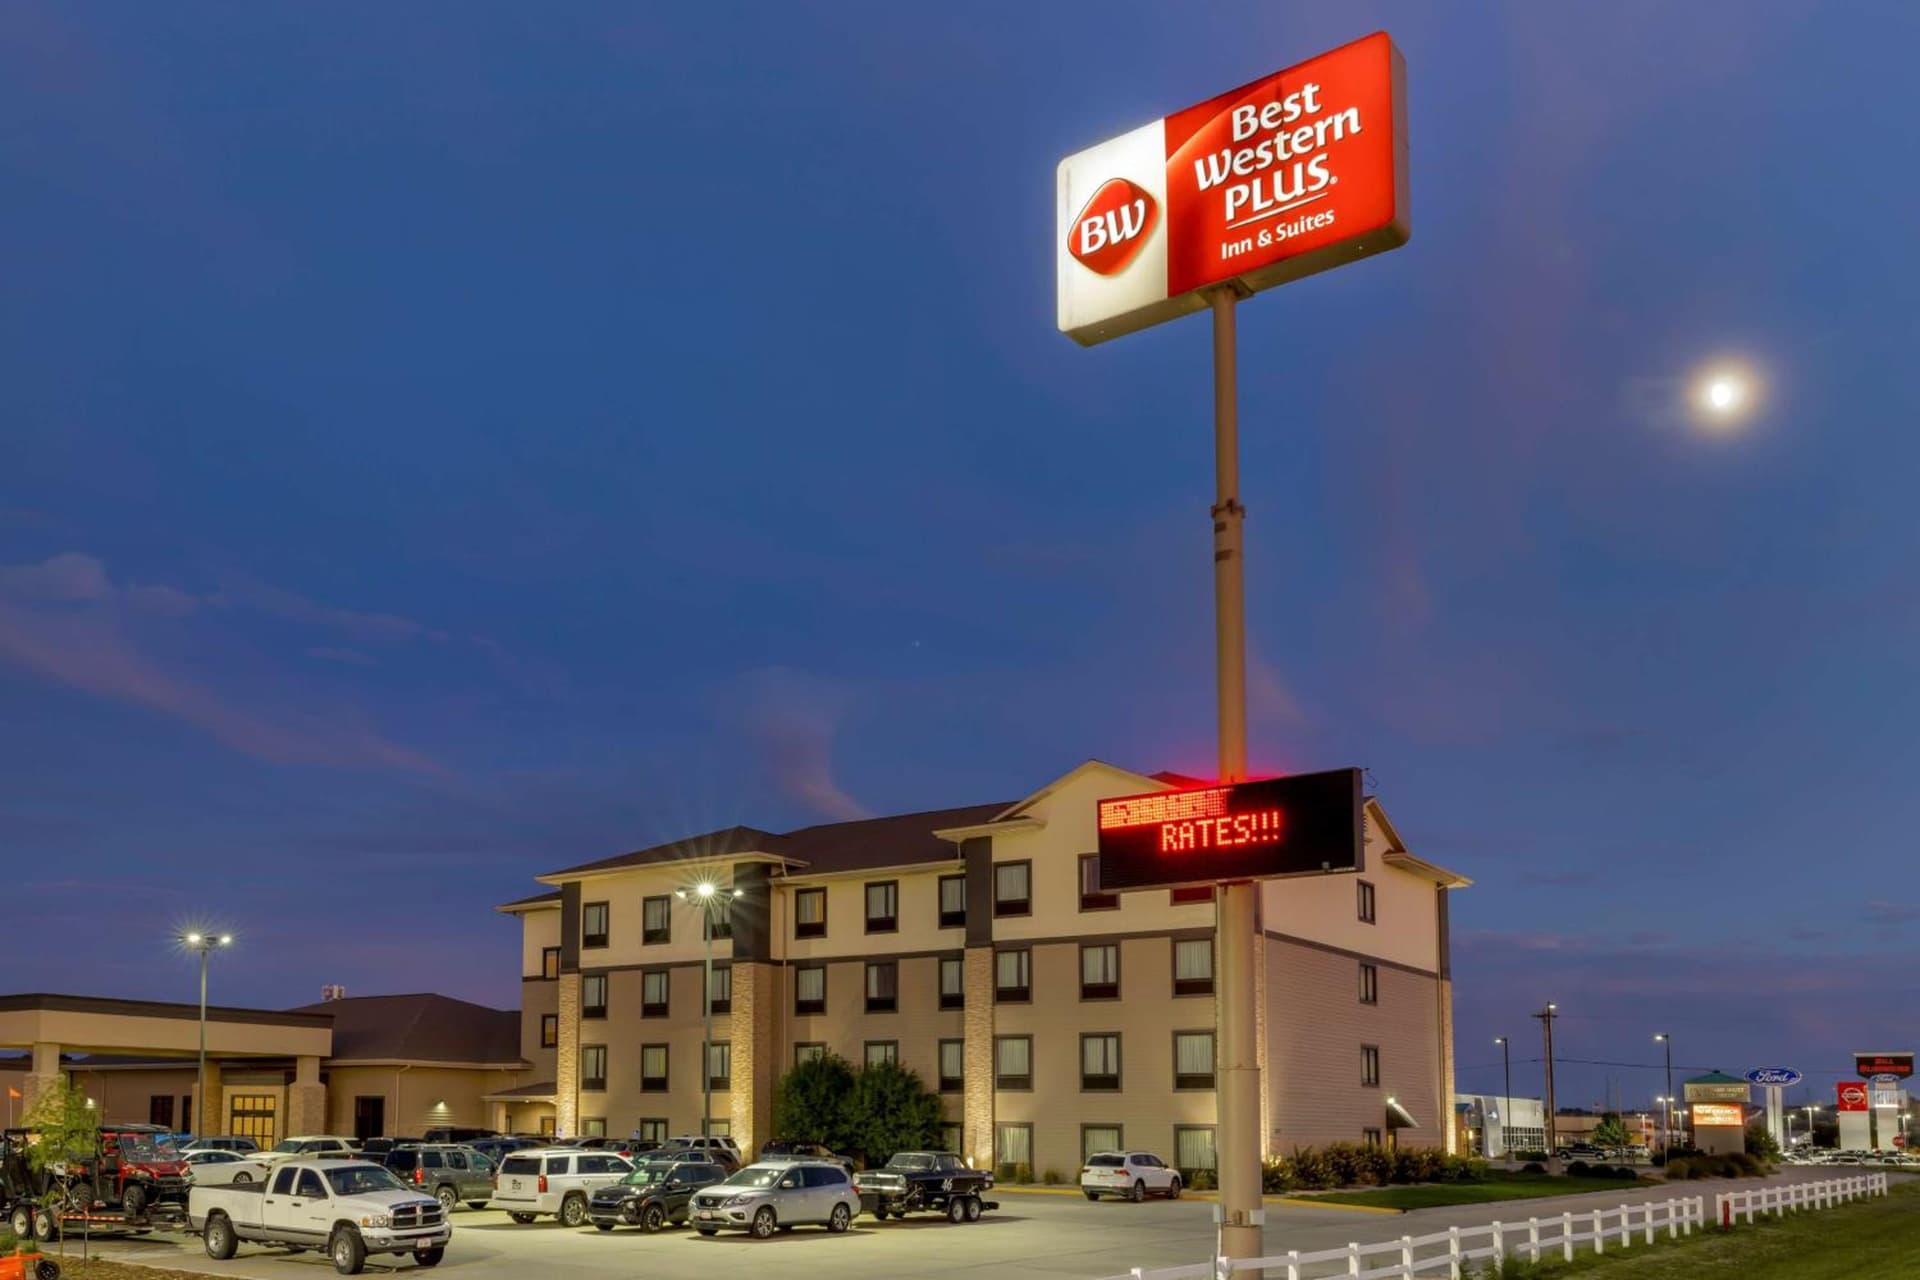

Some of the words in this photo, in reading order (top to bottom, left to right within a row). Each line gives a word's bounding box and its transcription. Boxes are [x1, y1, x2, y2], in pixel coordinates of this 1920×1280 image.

[1231, 82, 1322, 143] Best
[1193, 106, 1362, 191] Western
[1080, 199, 1146, 256] BW
[1221, 234, 1253, 260] Inn
[1257, 229, 1273, 248] &
[1275, 209, 1336, 243] Suites
[1162, 811, 1279, 851] RATES!!!
[1755, 1070, 1789, 1082] Ford
